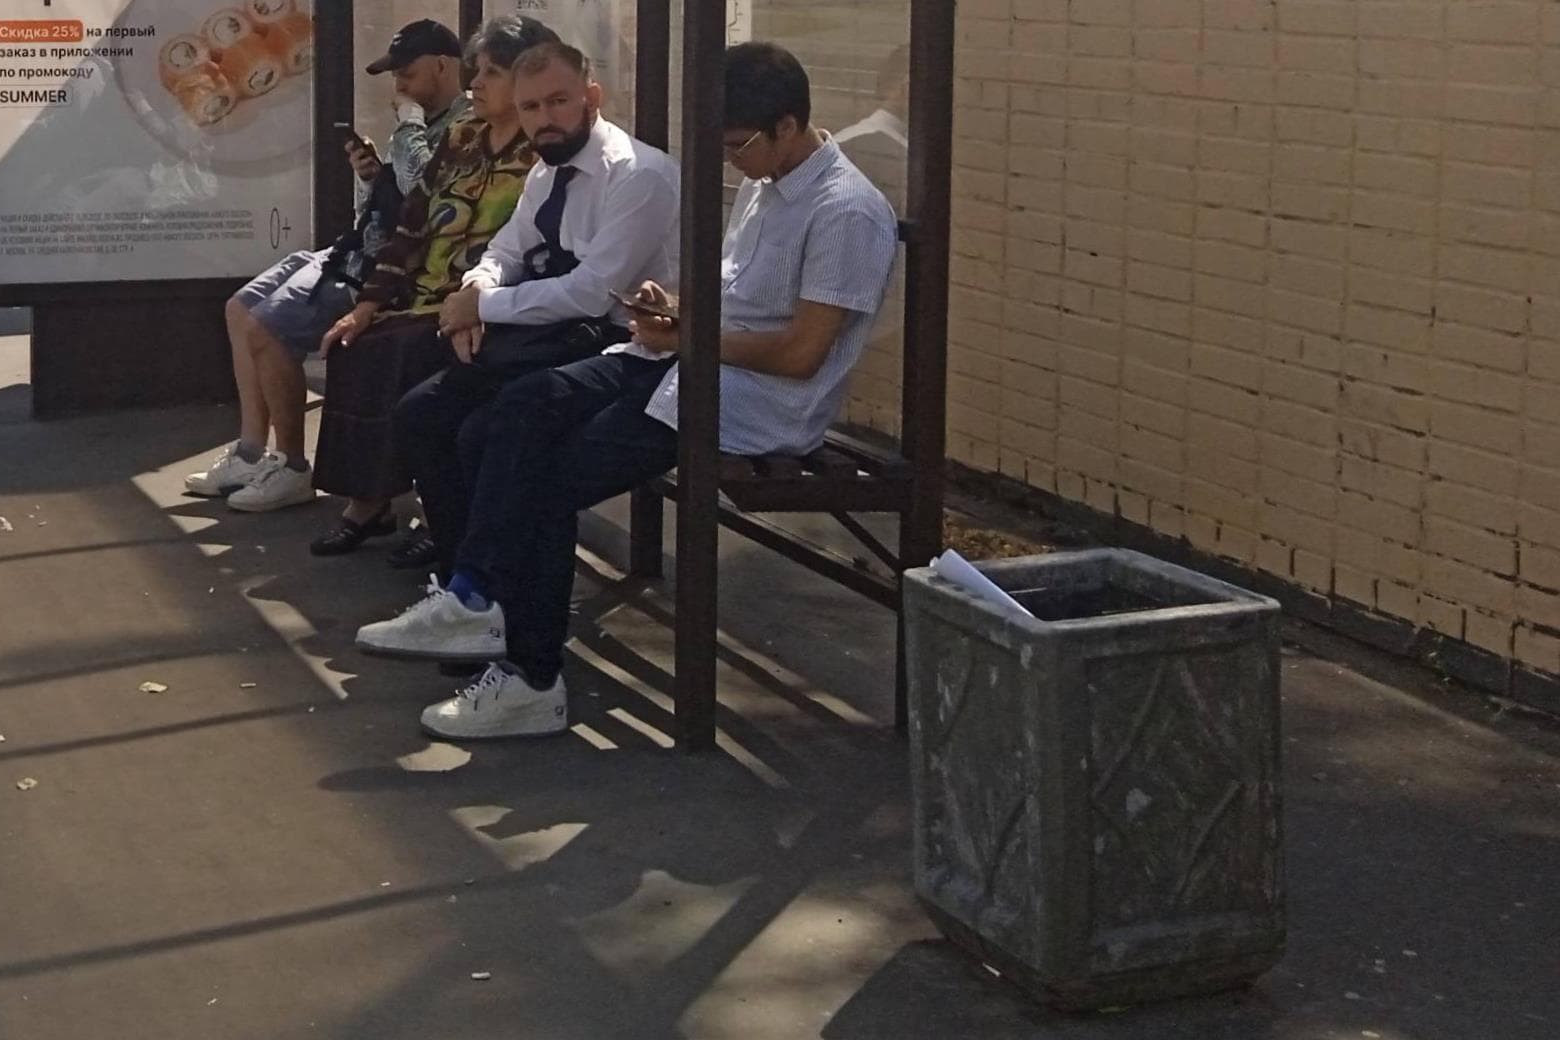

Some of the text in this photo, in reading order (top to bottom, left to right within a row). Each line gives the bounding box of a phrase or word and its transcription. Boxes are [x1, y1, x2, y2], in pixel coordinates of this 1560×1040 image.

[0, 25, 156, 40] Скидка 25% на первый
[0, 46, 134, 59] заказ в приложении
[0, 67, 94, 81] по промокоду
[0, 90, 67, 103] SUMMER
[269, 207, 292, 250] 0+
